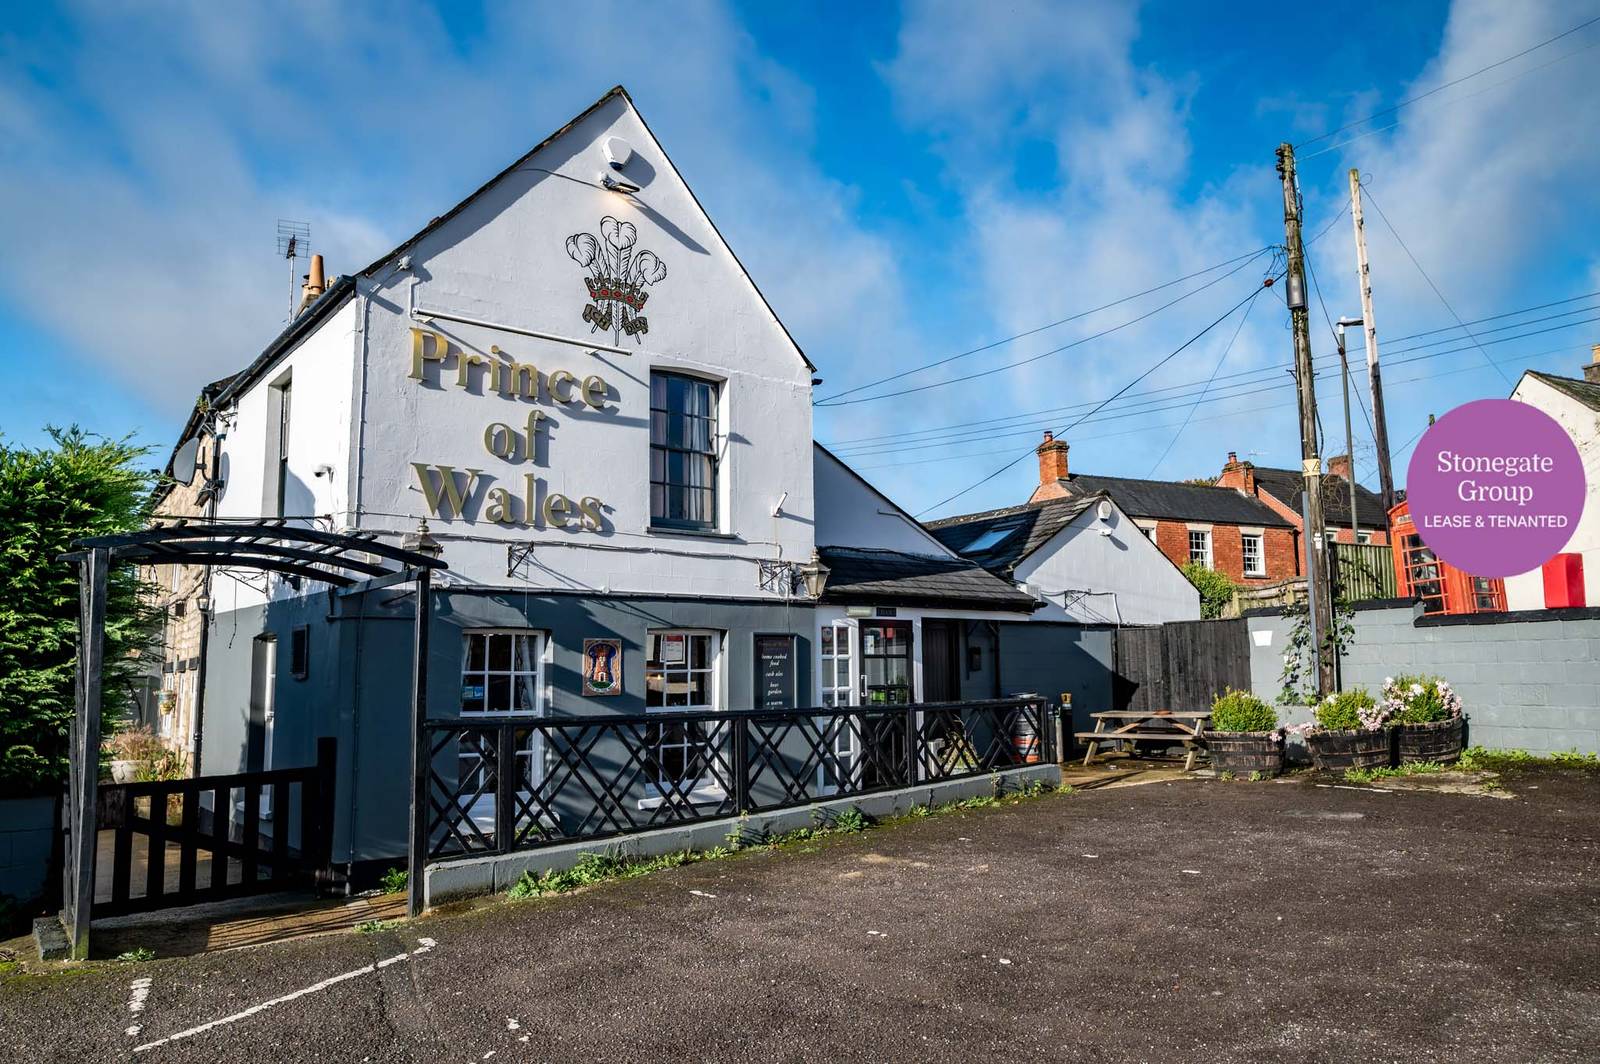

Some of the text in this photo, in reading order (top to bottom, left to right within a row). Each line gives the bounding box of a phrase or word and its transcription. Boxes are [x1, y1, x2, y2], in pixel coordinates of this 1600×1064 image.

[408, 327, 608, 408] Prince
[484, 410, 546, 462] of
[410, 462, 604, 530] Wales
